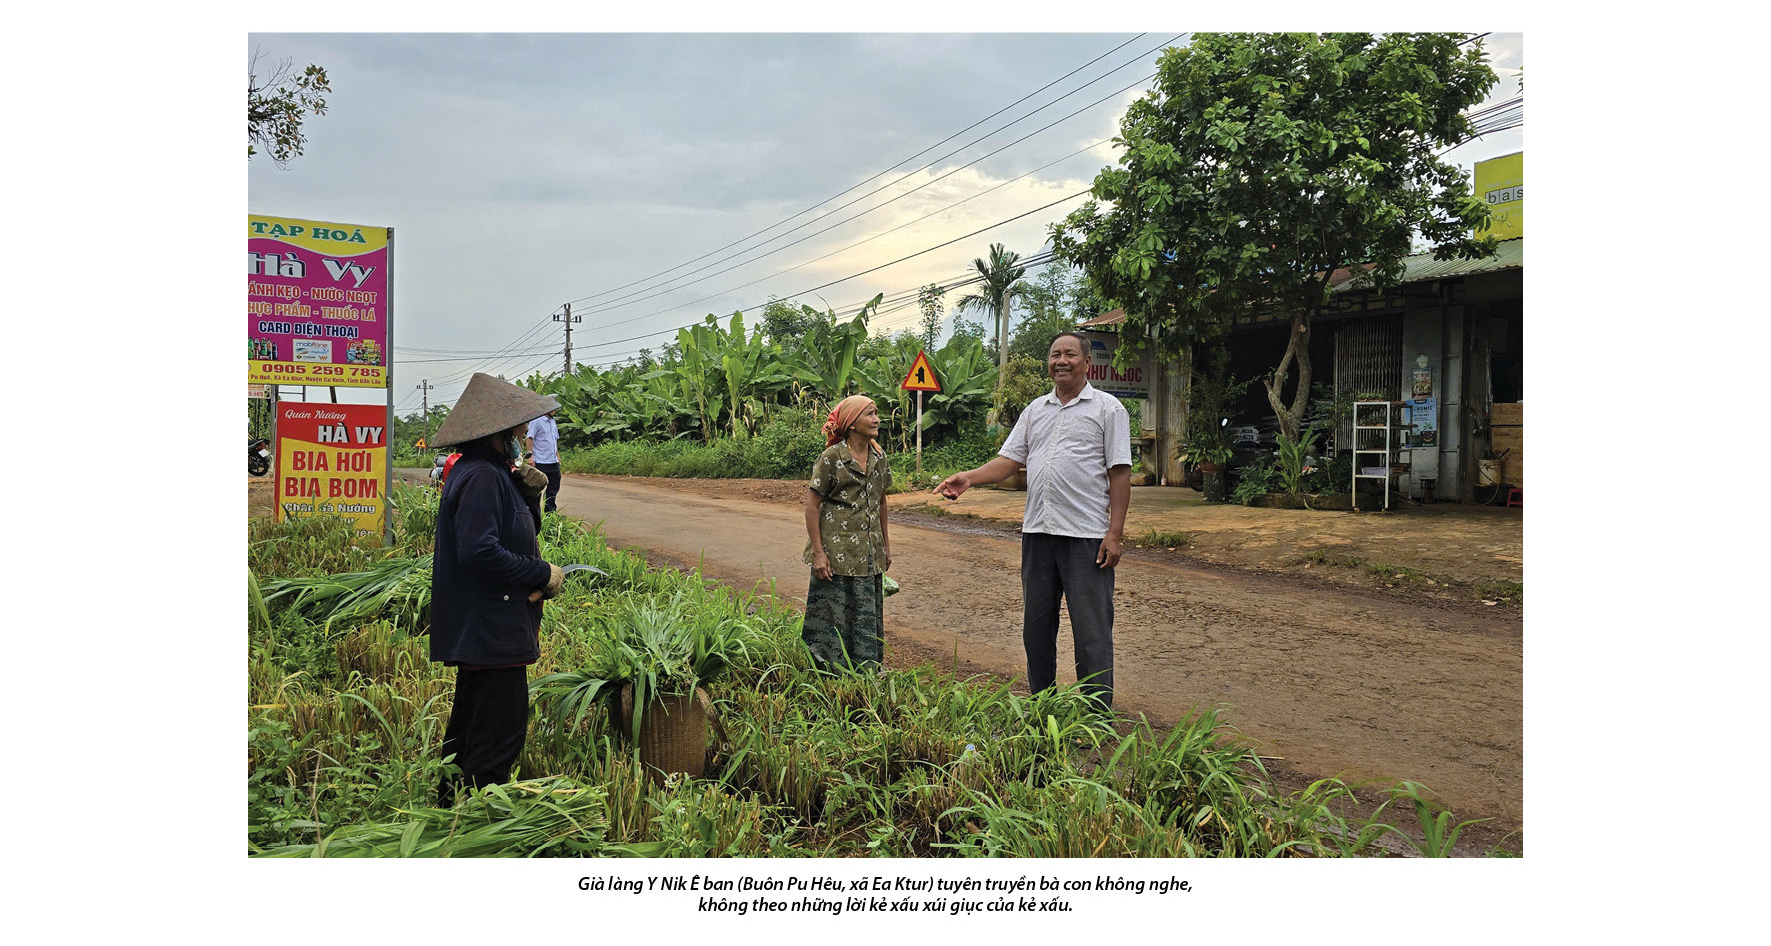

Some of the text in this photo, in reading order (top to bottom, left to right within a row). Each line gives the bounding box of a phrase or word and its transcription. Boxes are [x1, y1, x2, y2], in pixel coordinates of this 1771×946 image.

[251, 221, 366, 244] TẠP HOÁ
[248, 252, 377, 288] Hà Vy
[277, 285, 300, 299] KẸO
[311, 287, 344, 302] NƯỚC
[346, 291, 377, 306] NGỌT
[321, 305, 359, 321] THUỐC
[361, 307, 376, 322] LÁ
[259, 321, 358, 340] CARD ĐIỆN THOẠI
[262, 363, 381, 378] 0905 259 785
[284, 409, 311, 419] Quán
[317, 422, 384, 444] HÀ VY
[292, 450, 372, 473] BIA HƠI
[285, 476, 378, 499] BIA BOM
[285, 503, 315, 512] Chân
[337, 503, 376, 514] Nướng
